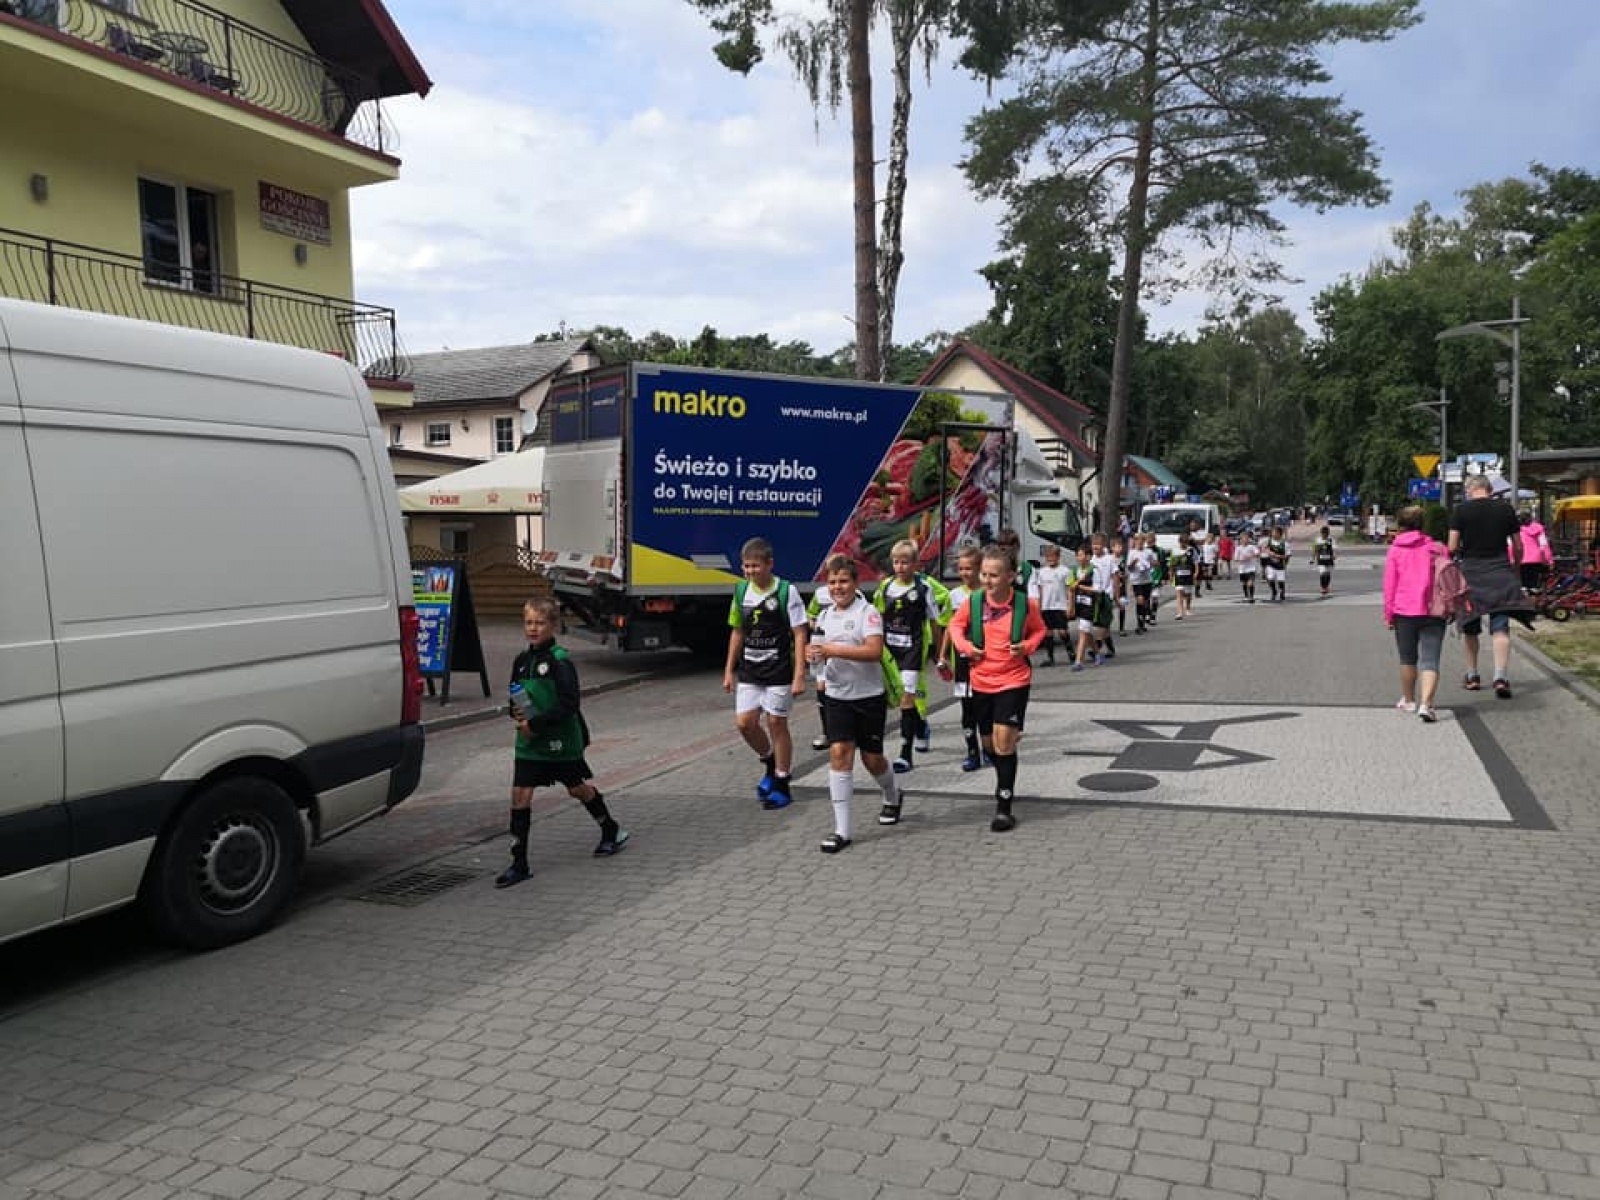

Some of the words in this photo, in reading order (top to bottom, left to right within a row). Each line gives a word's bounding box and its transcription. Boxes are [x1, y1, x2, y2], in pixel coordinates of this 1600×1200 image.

[654, 390, 746, 418] makro
[780, 406, 867, 424] www.makro.pl
[654, 449, 729, 476] Świeżo
[736, 457, 742, 477] i
[749, 460, 816, 483] szybko
[654, 482, 676, 499] do
[681, 484, 733, 504] Twojej
[738, 489, 822, 507] restauracji
[752, 609, 762, 625] 5
